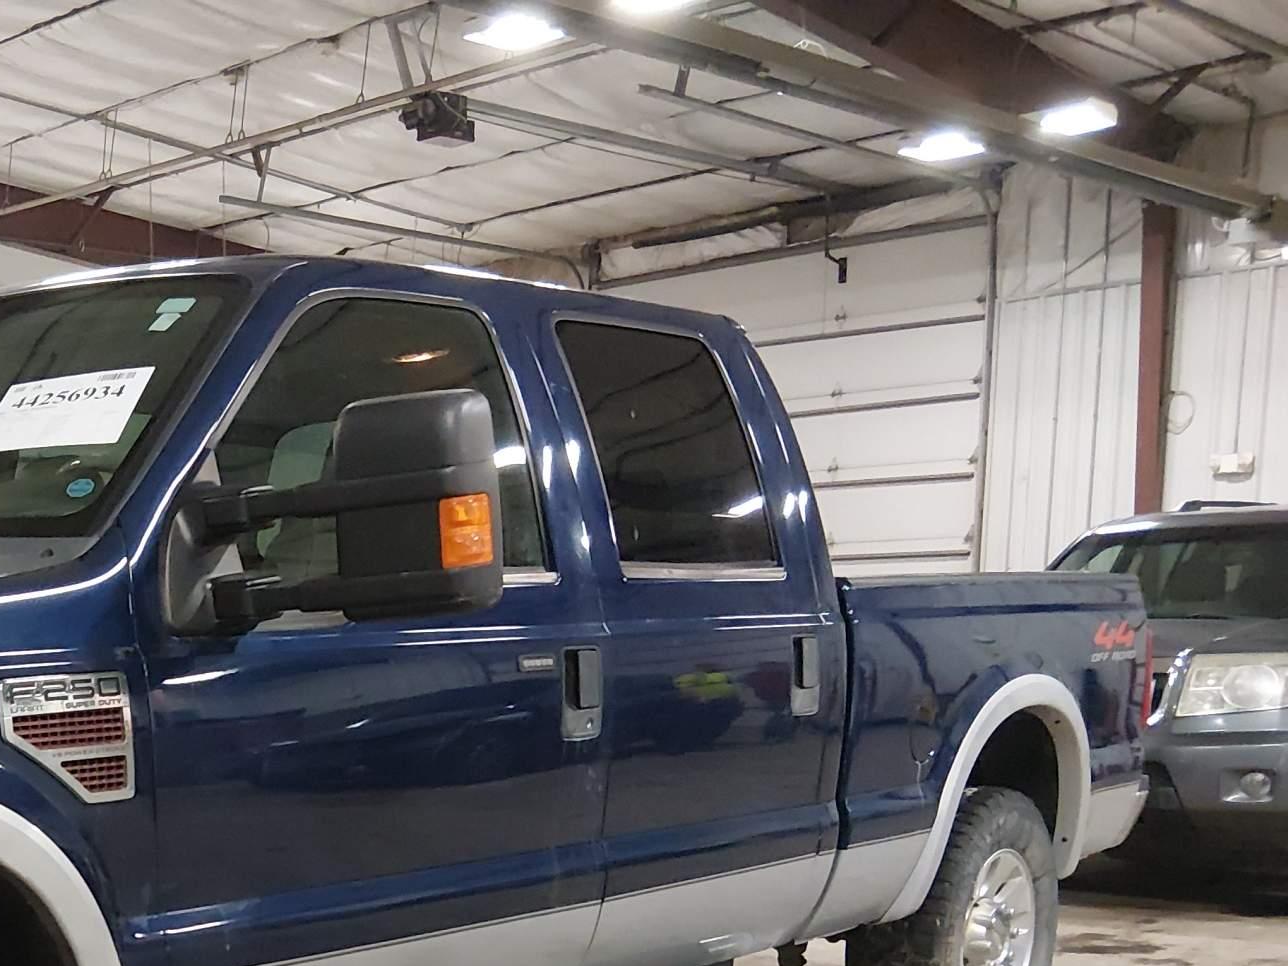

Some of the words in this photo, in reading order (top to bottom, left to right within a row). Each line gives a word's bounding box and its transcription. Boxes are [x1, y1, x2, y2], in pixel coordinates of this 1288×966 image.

[11, 383, 128, 410] 44256934
[65, 700, 96, 709] SUPER
[98, 698, 122, 706] DUTY
